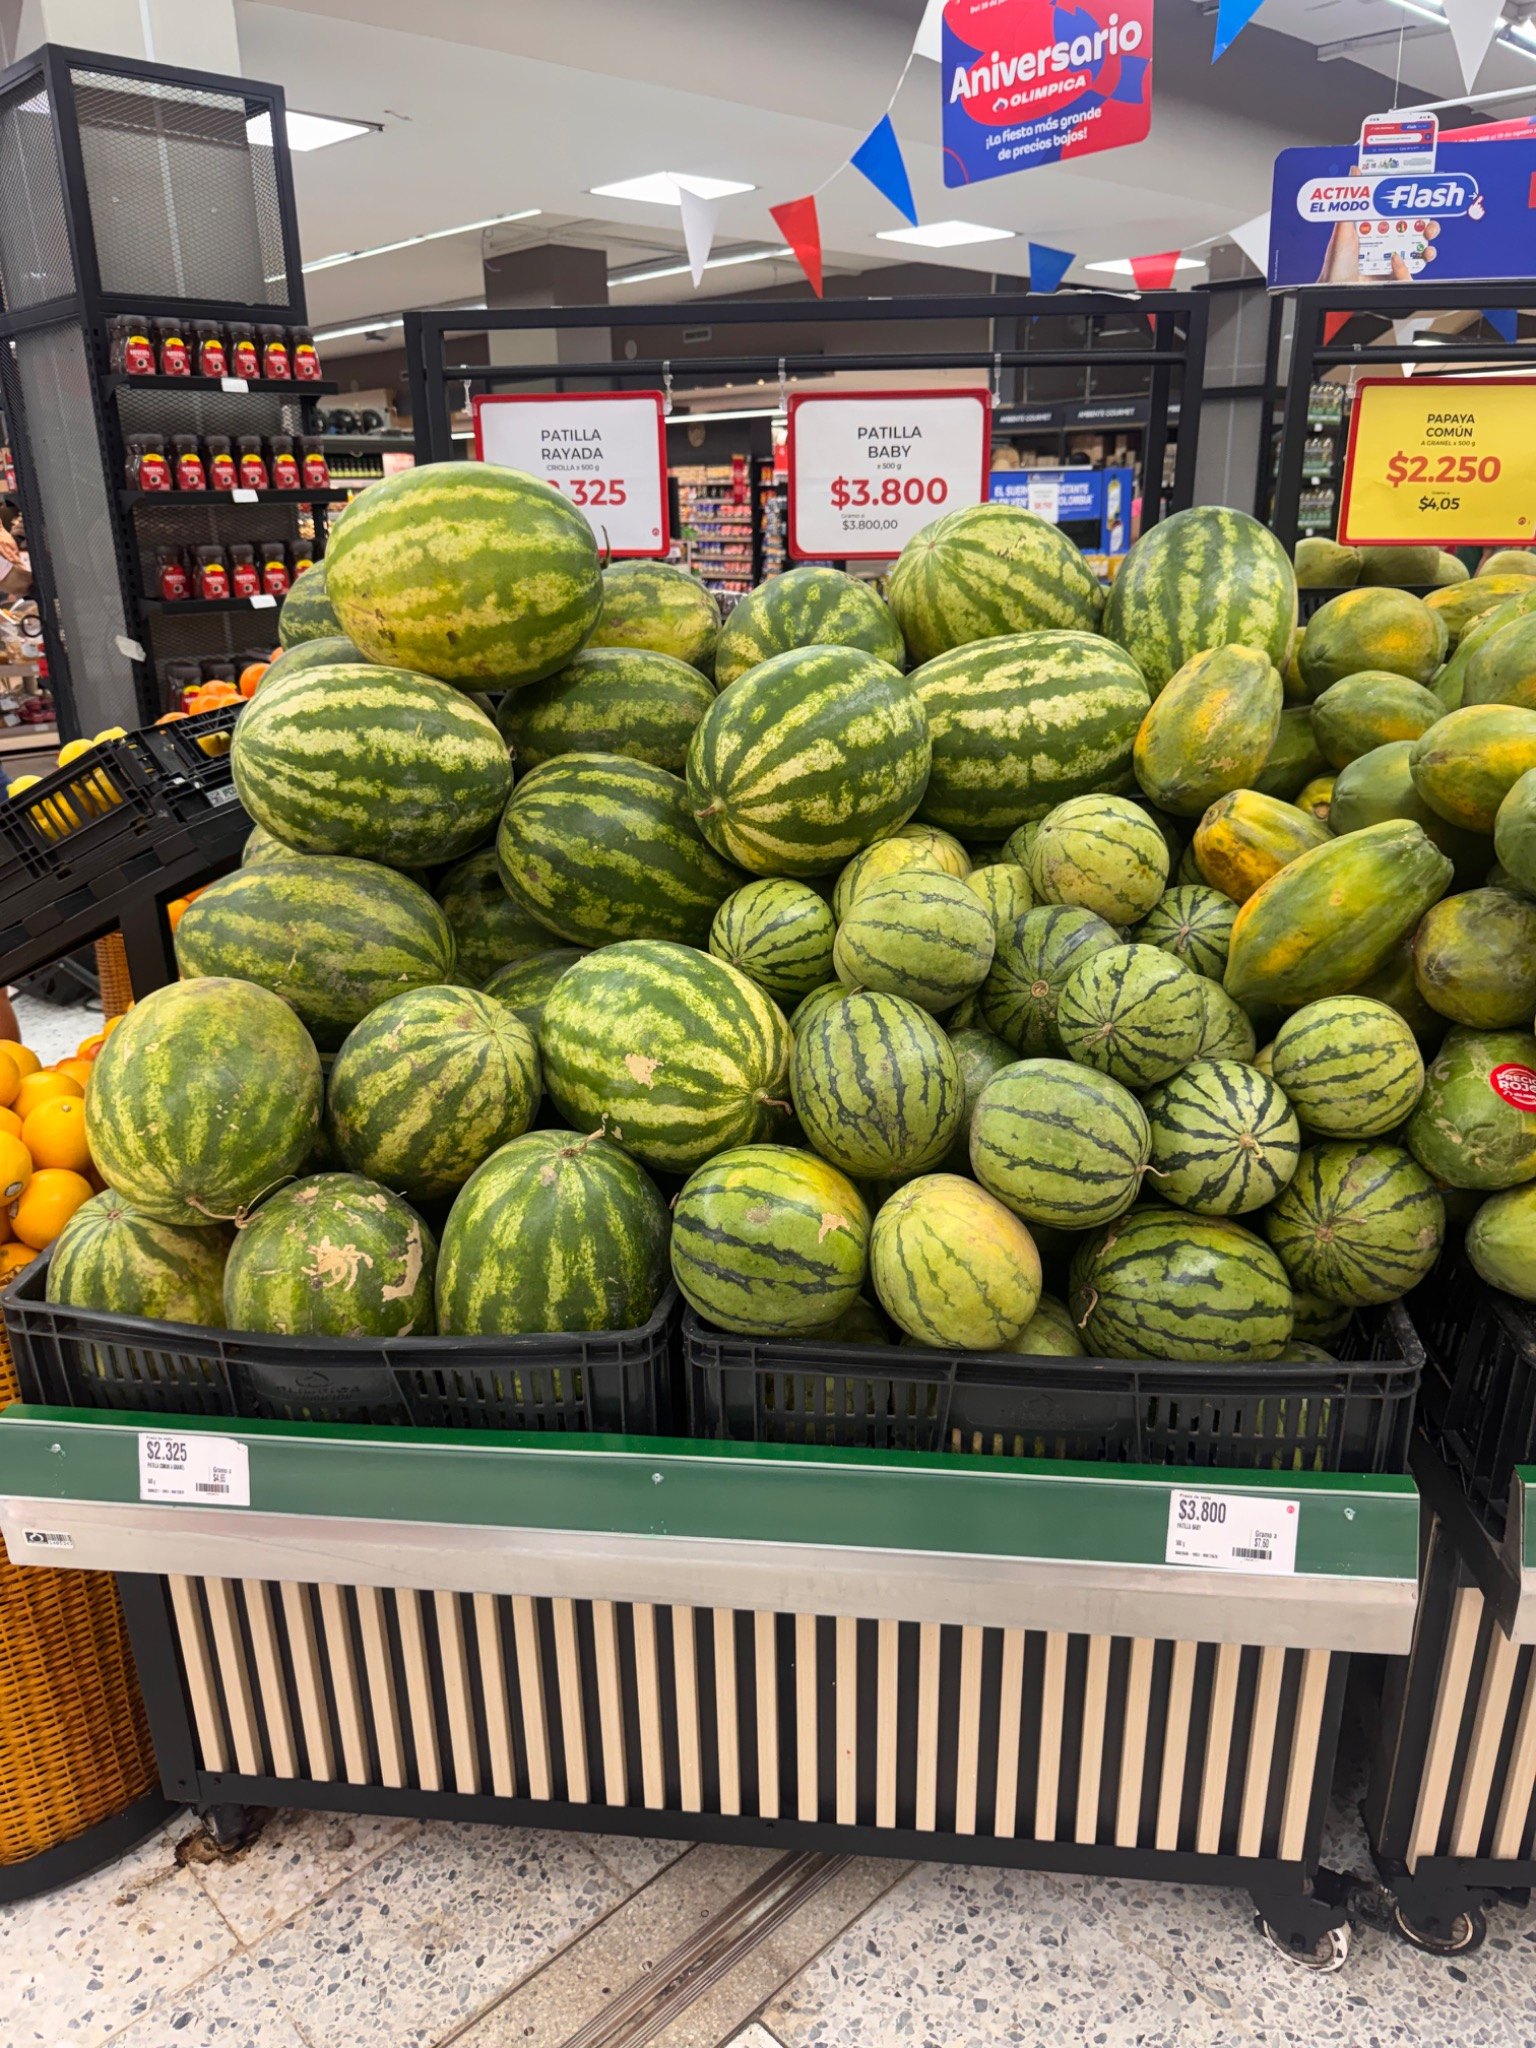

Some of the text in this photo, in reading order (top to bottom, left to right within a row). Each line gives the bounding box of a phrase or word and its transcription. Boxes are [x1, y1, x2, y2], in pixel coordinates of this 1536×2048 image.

[950, 13, 1143, 104] Aniversario
[1010, 75, 1086, 107] OLIMPICA
[986, 107, 1102, 150] ¡La fiesta más grande
[997, 127, 1088, 161] de precios bajos!
[1310, 182, 1466, 209] ACTIVA Flash
[1310, 201, 1370, 213] EL MODO
[1427, 414, 1475, 424] PAPAYA
[541, 429, 602, 442] PATILLA
[858, 426, 922, 440] PATILLA
[1426, 425, 1473, 437] COMÚN
[541, 447, 604, 460] RAYADA
[868, 445, 911, 458] BABY
[1386, 450, 1501, 488] $2.250
[547, 479, 627, 506] 325
[830, 475, 948, 511] $3.800
[1418, 496, 1460, 512] $4,05
[842, 520, 898, 531] $3.800,00
[146, 1441, 187, 1461] $2.325
[1178, 1499, 1227, 1523] $3.800
[1255, 1530, 1272, 1539] Gramo
